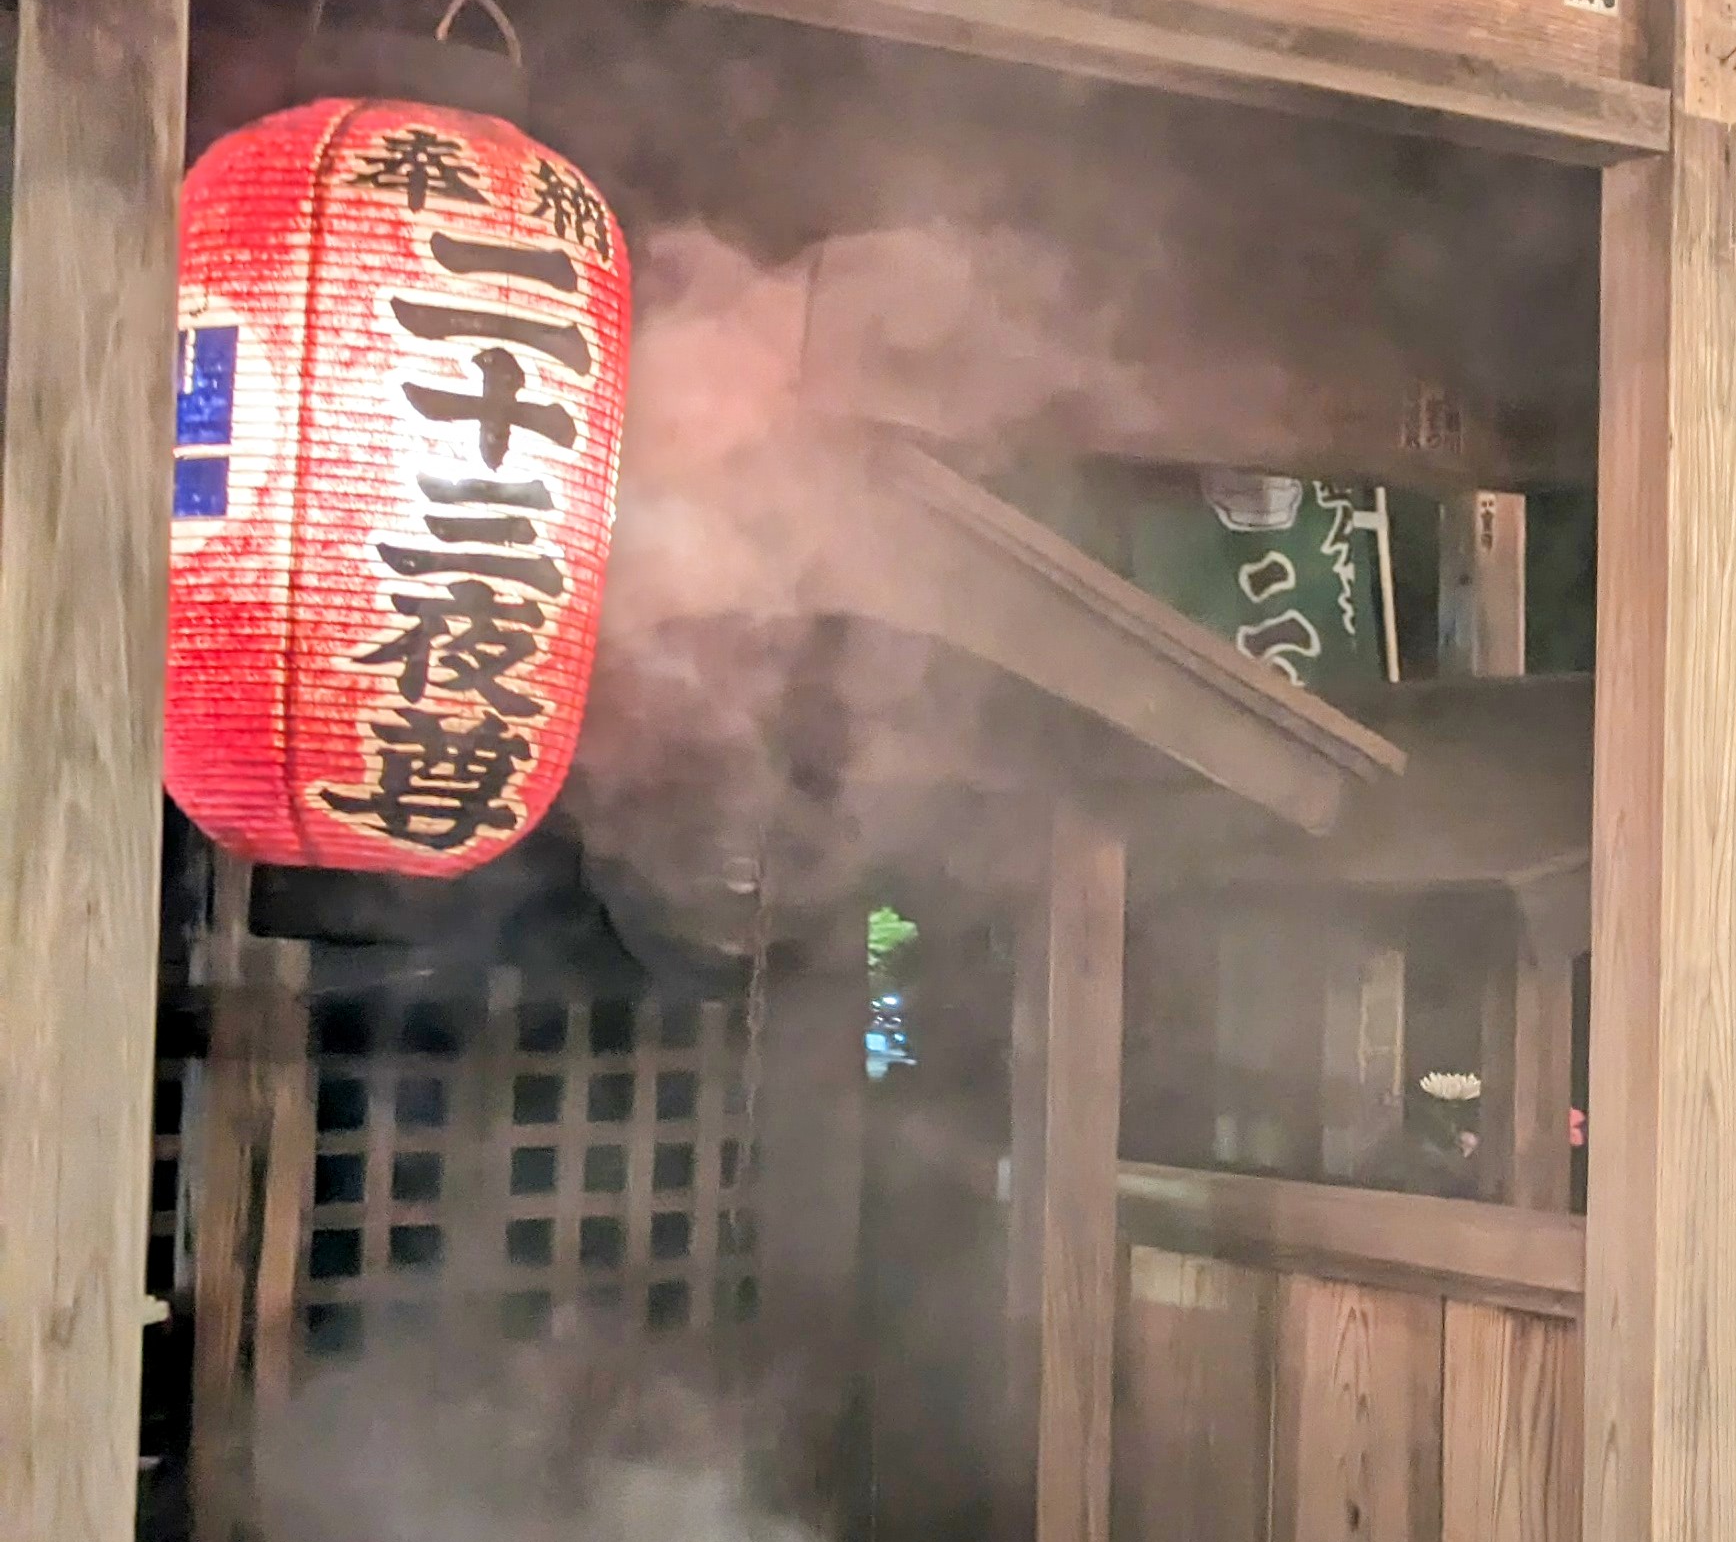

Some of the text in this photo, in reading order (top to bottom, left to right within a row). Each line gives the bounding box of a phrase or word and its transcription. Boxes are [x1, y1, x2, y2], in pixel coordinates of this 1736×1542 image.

[319, 229, 594, 851] 二十三夜尊
